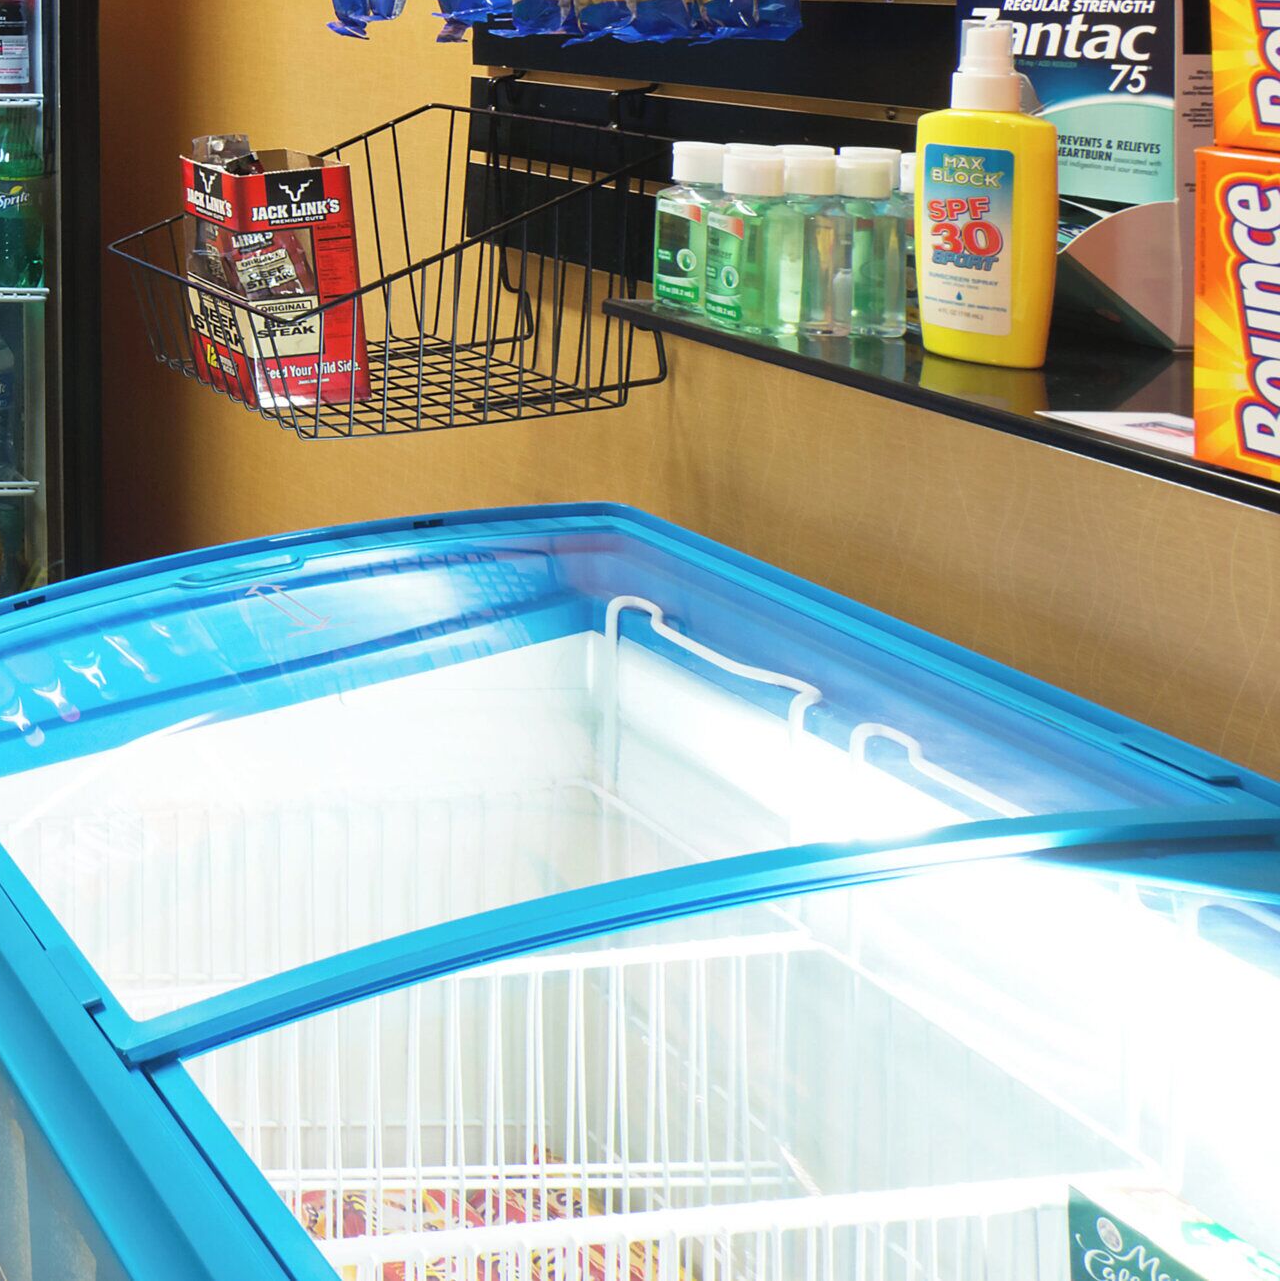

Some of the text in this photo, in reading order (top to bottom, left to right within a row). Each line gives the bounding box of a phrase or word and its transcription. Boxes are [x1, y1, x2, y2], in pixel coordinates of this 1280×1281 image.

[1072, 0, 1156, 14] STRENGTH
[1108, 64, 1149, 94] 75
[1057, 134, 1161, 155] PREVENTS & RELIEVES
[1057, 147, 1113, 162] HEARTBURN
[943, 155, 986, 171] MAX
[931, 168, 1005, 188] BLOCK
[186, 188, 233, 218] JACK LINK'S
[252, 199, 340, 221] JACK LINK'S
[928, 197, 990, 221] SPF
[270, 217, 303, 225] PREMIUM
[931, 220, 1003, 256] 30
[932, 250, 1000, 272] SPORT
[260, 302, 308, 313] ORIGINAL
[257, 325, 316, 339] STEAK
[289, 364, 313, 378] Your
